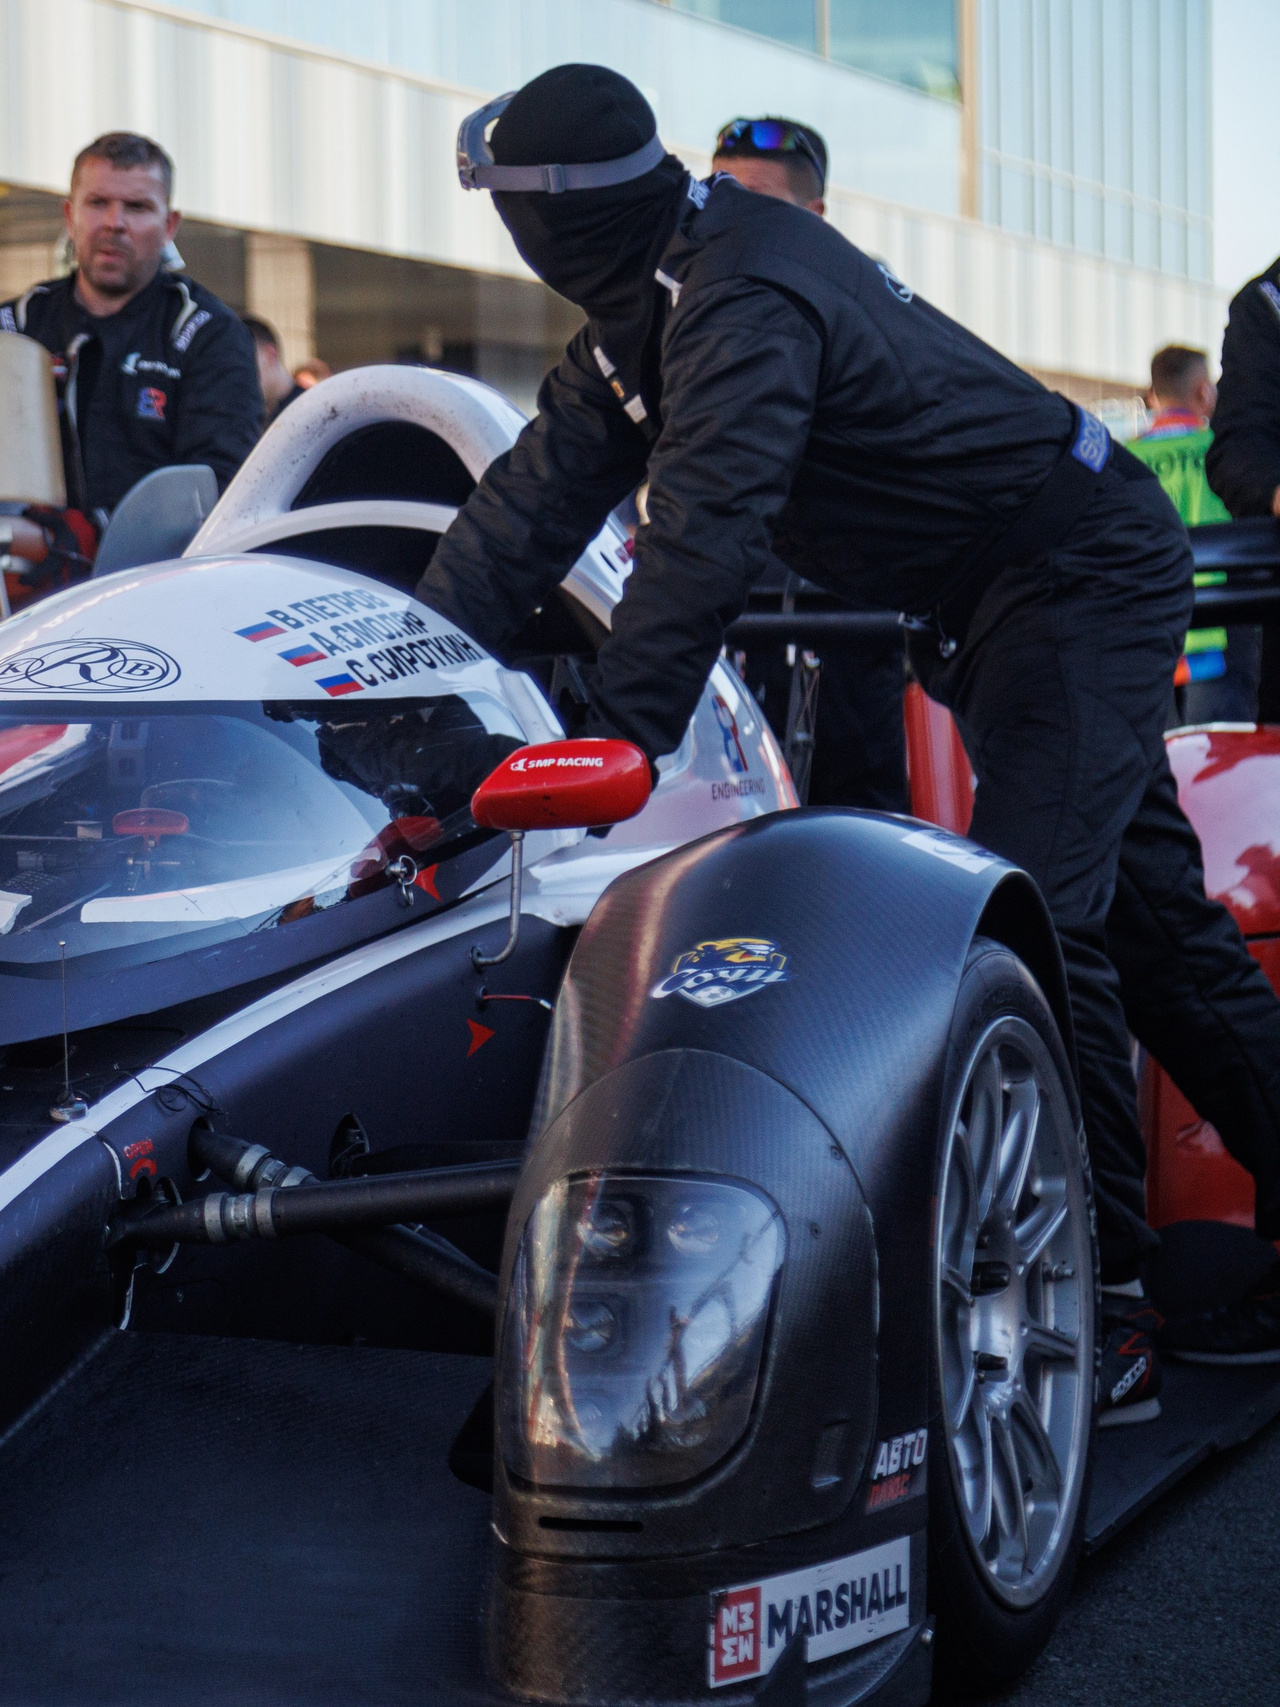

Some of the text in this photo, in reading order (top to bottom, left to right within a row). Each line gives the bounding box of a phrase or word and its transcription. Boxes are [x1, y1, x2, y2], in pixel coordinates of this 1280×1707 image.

[265, 588, 391, 630] В.ПЕТРОВ
[345, 632, 484, 687] С.СИРОТКИН
[528, 757, 604, 768] SMP RACING
[872, 1428, 928, 1480] АВТО
[767, 1563, 908, 1650] MARSHALL
